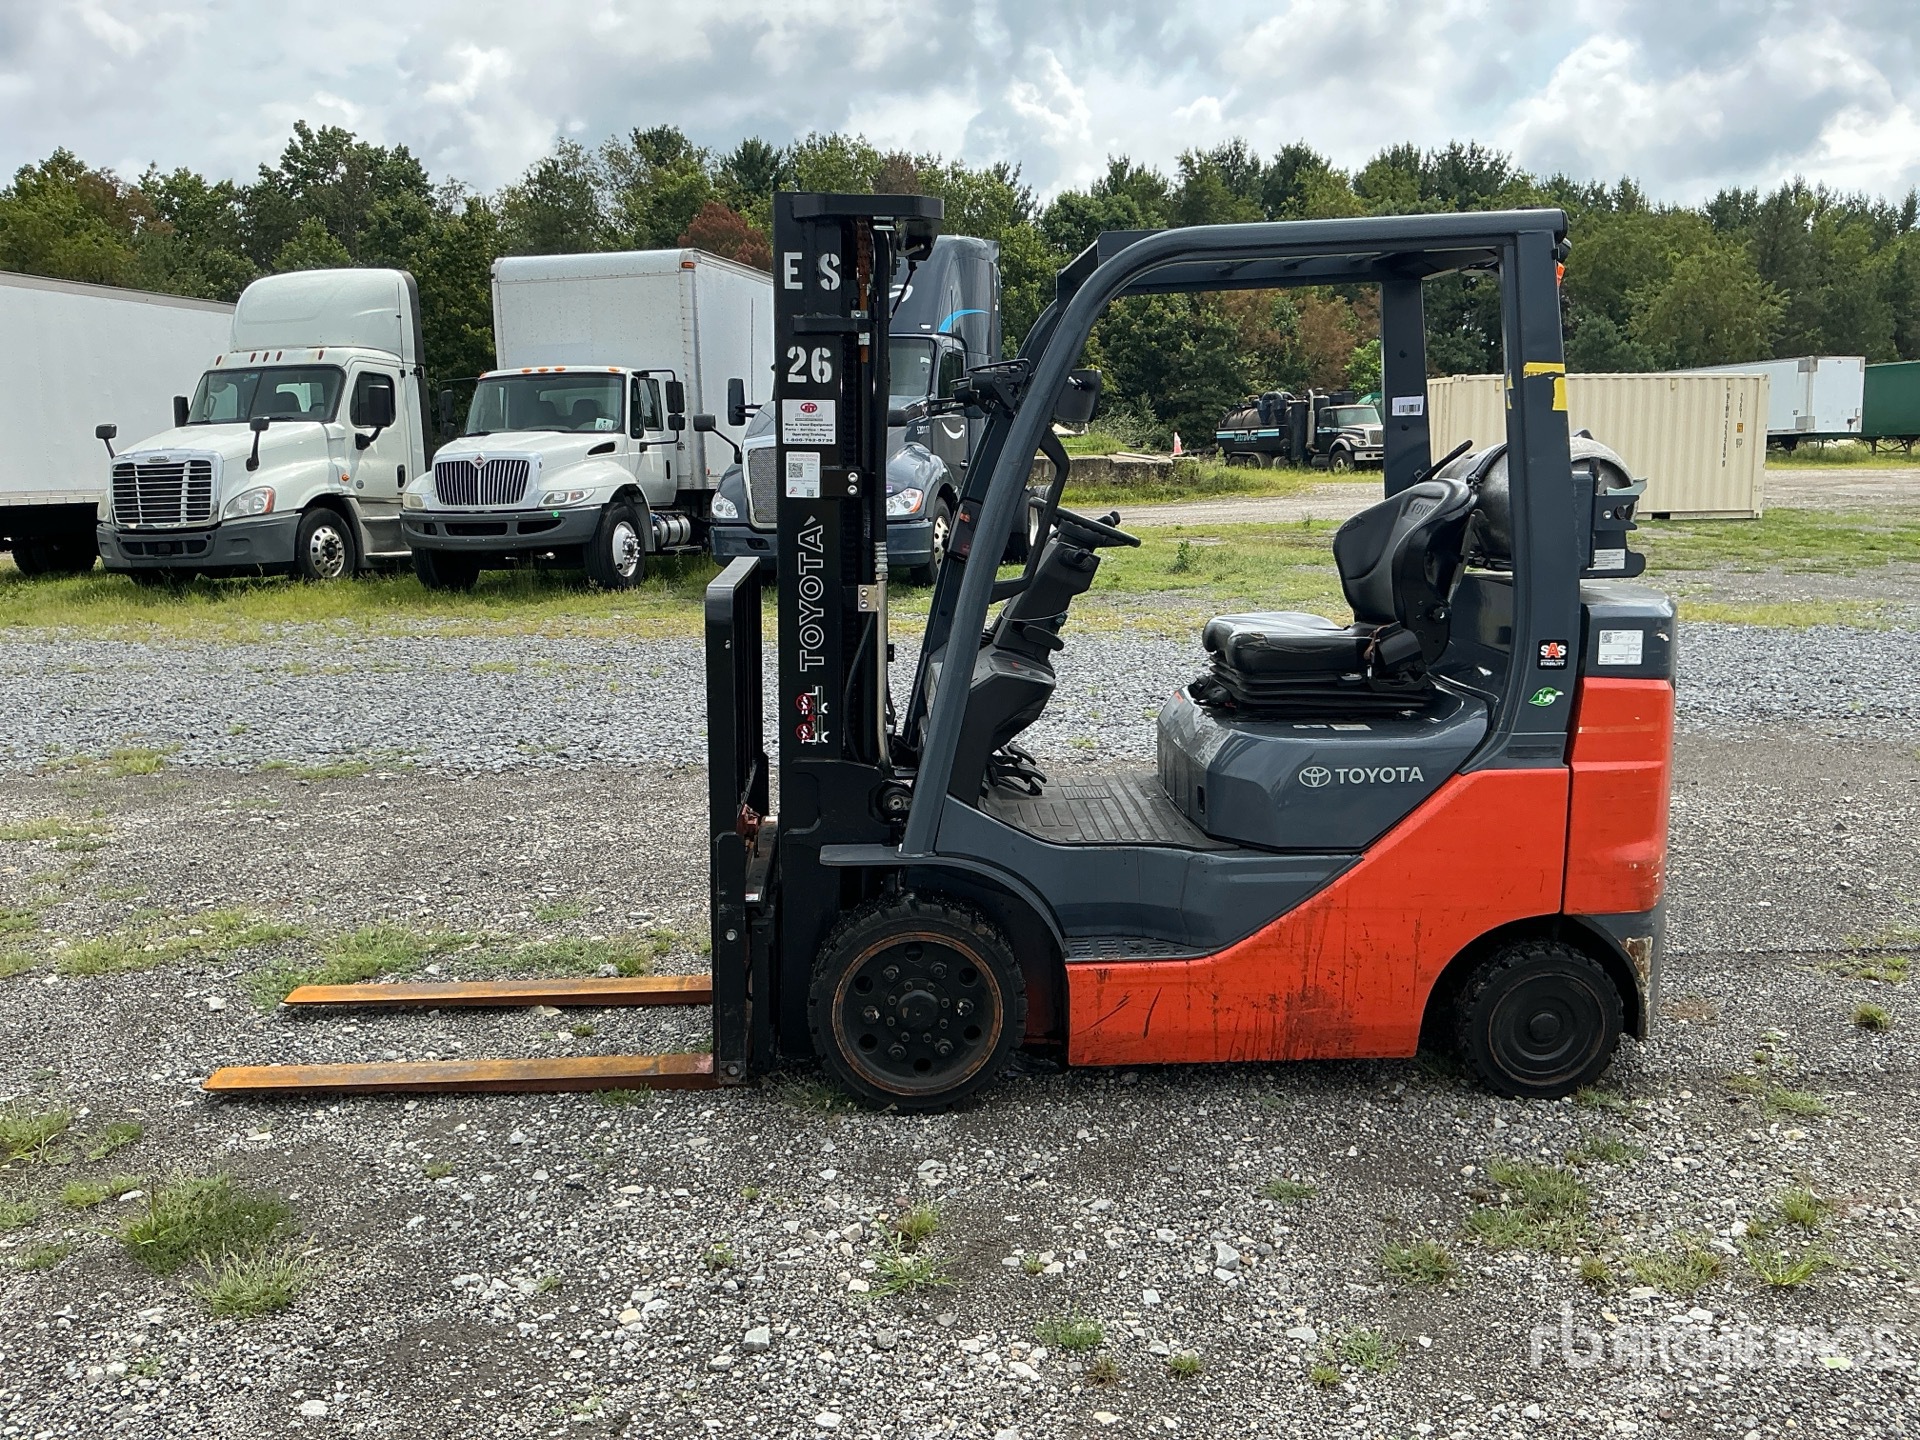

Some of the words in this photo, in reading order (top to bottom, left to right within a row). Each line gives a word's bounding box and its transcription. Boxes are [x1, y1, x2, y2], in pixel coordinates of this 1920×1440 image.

[787, 346, 832, 383] 26
[798, 525, 825, 672] TOYOTA
[1540, 642, 1567, 658] SAS
[1335, 767, 1424, 784] TOYOTA
